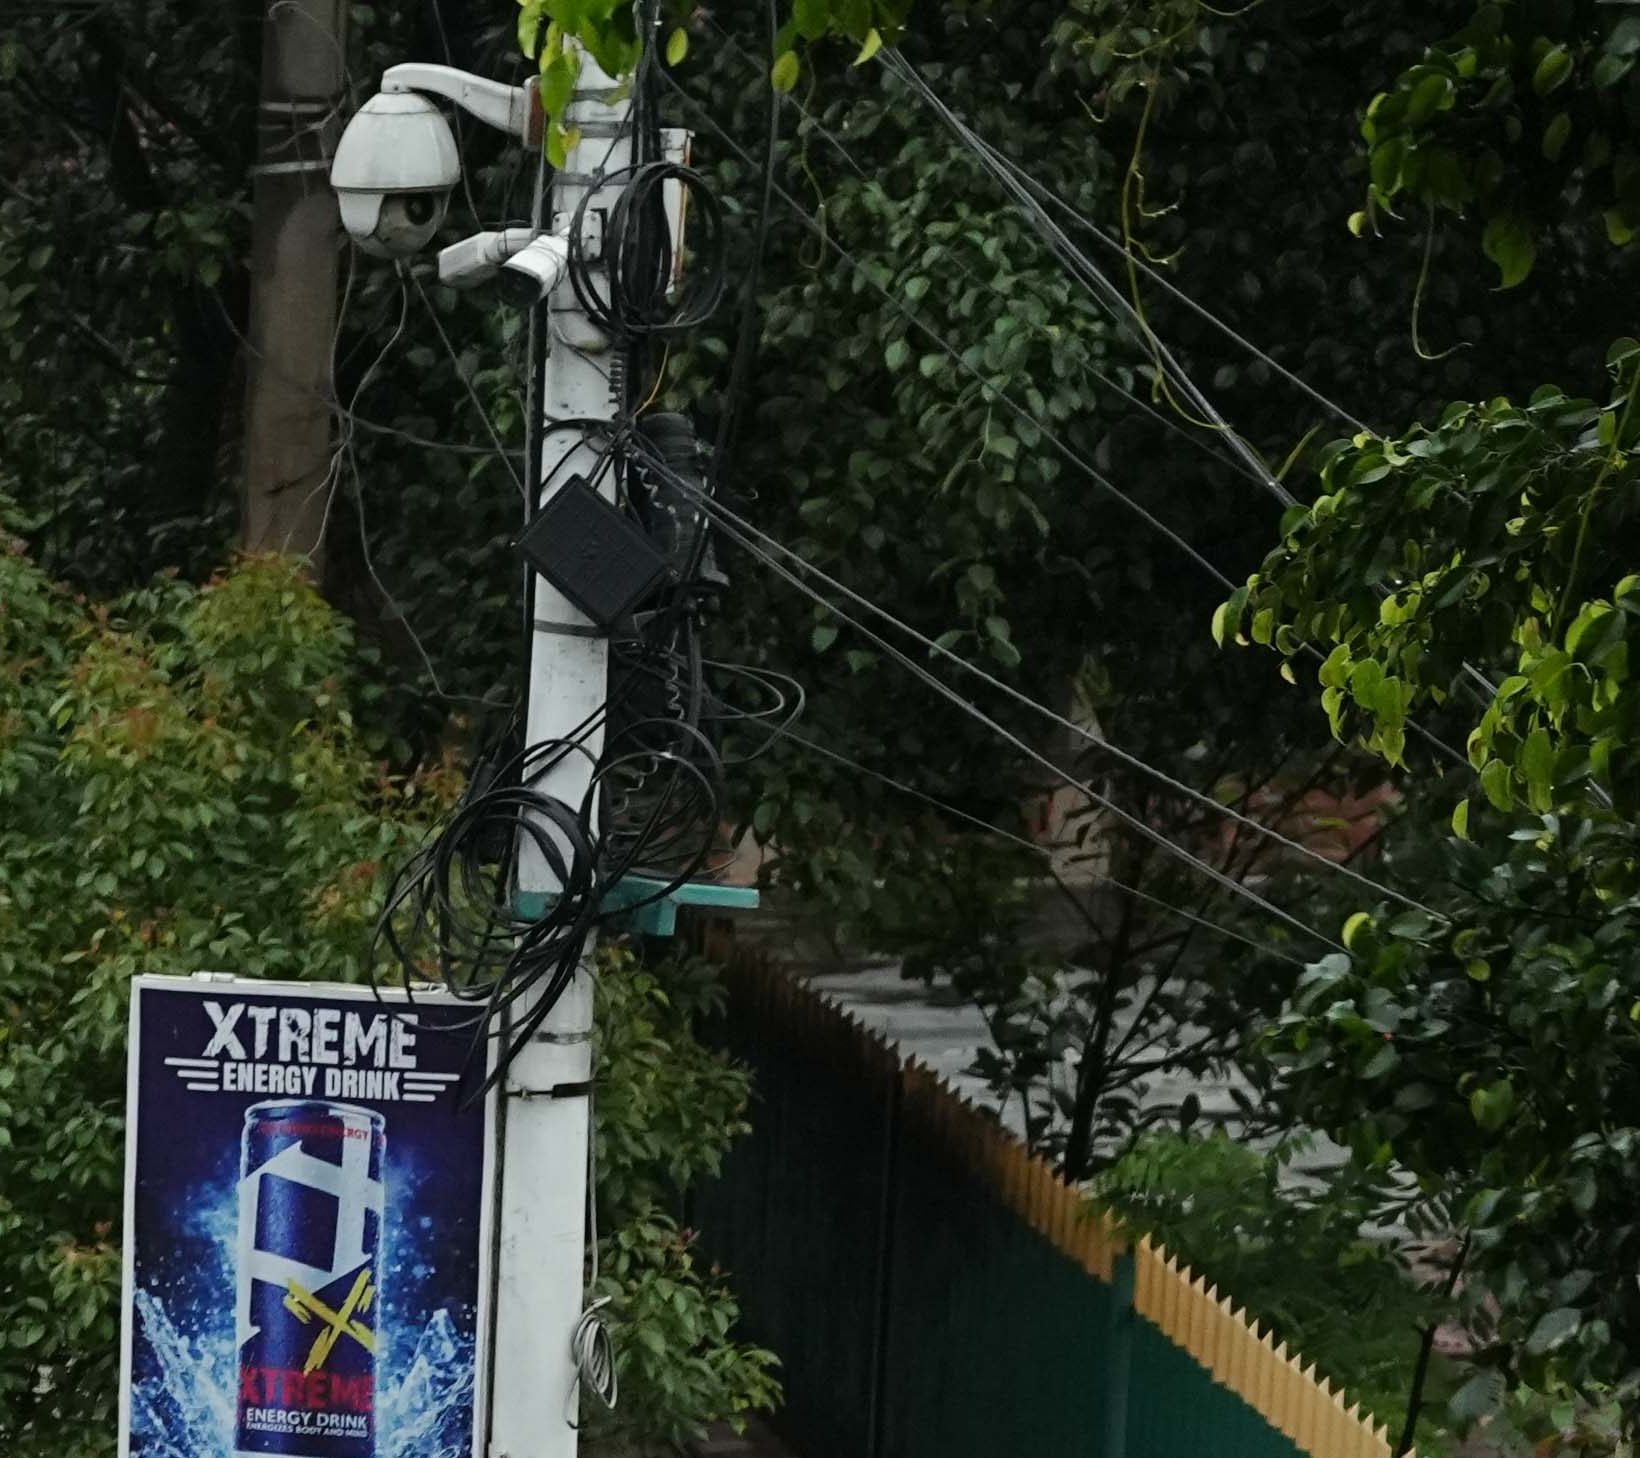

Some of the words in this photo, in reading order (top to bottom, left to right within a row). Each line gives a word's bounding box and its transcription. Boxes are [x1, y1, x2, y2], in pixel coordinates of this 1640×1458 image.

[201, 1000, 418, 1069] XTREME
[222, 1060, 317, 1097] ENERGY
[324, 1063, 401, 1101] DRINK
[240, 1367, 376, 1412] XTREME
[246, 1408, 312, 1425] ENERGY
[316, 1413, 368, 1429] DRINK
